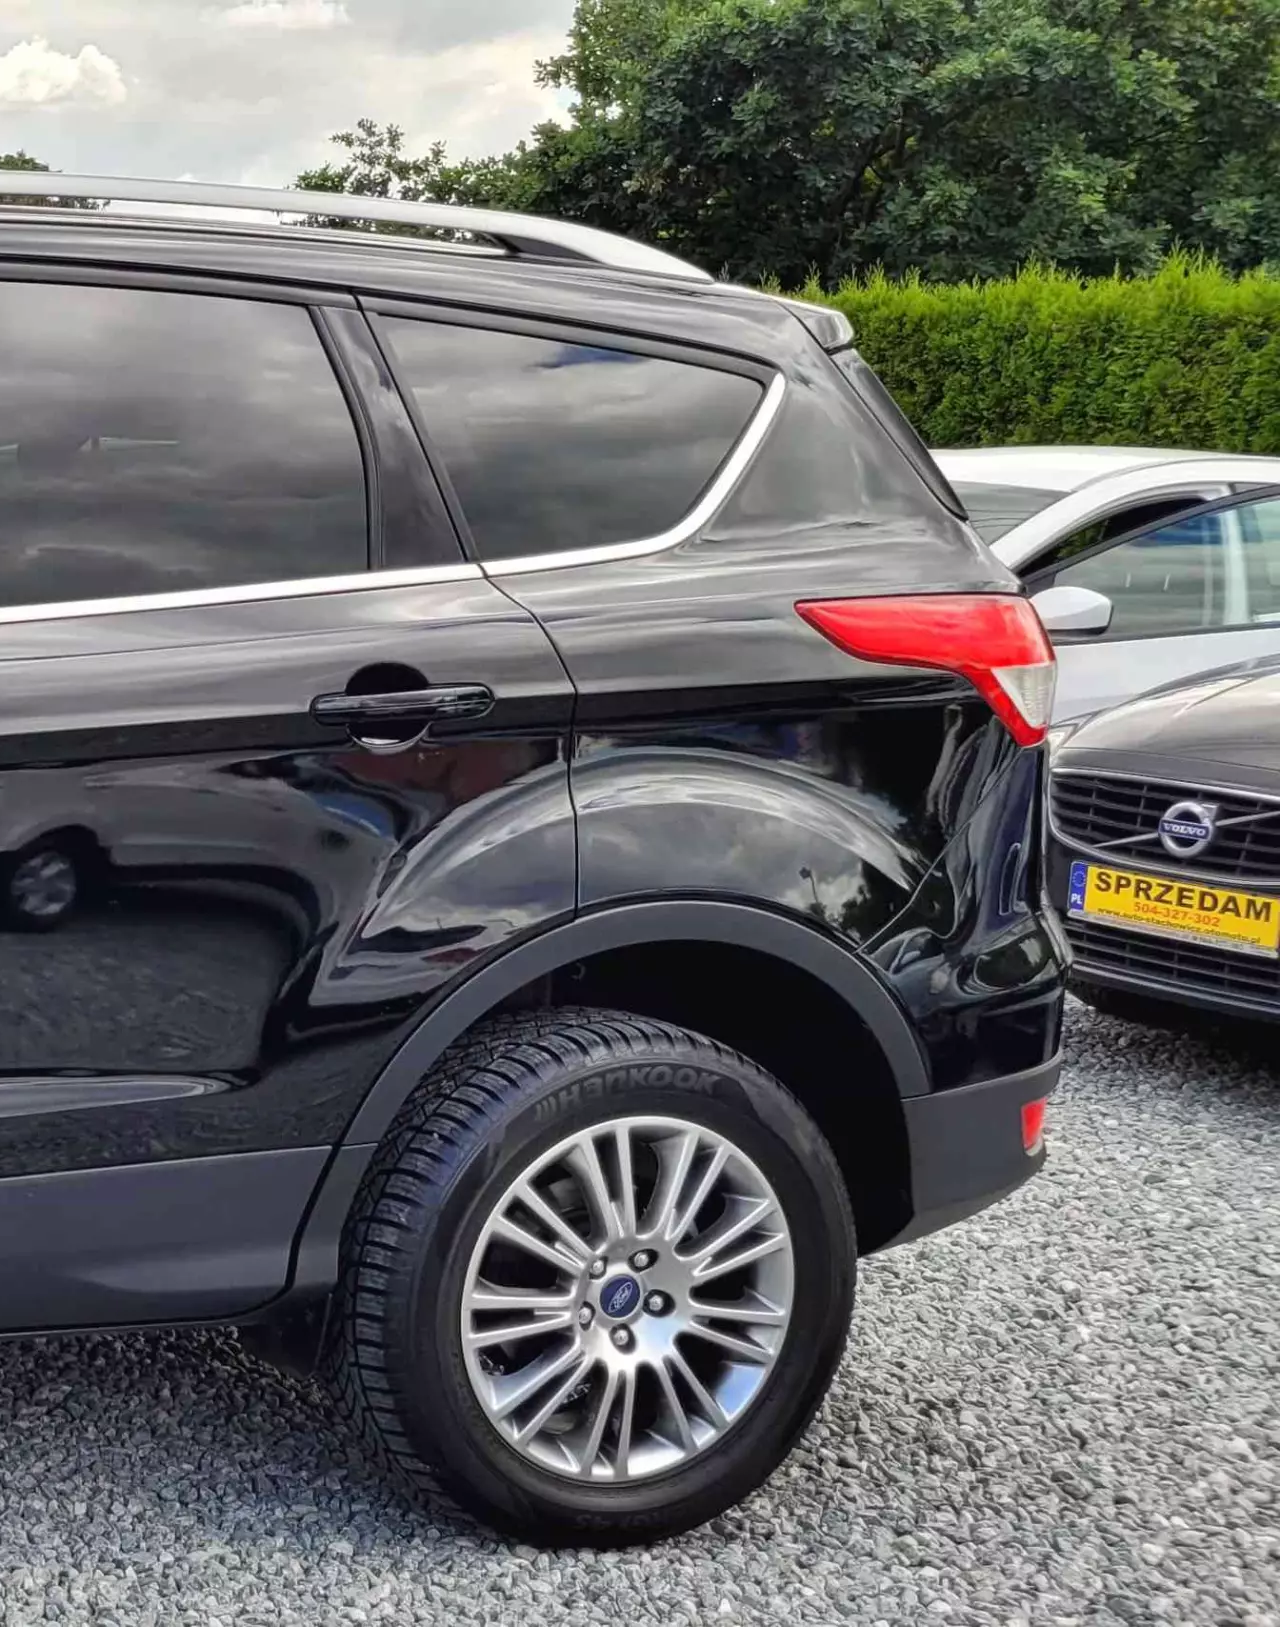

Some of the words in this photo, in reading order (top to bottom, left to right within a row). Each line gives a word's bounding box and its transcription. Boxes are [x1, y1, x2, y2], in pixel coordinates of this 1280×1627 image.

[1163, 822, 1206, 837] VOLVO
[1071, 893, 1083, 905] PL
[1094, 870, 1272, 923] SPRZEDAM
[1134, 902, 1221, 928] 504-327-302
